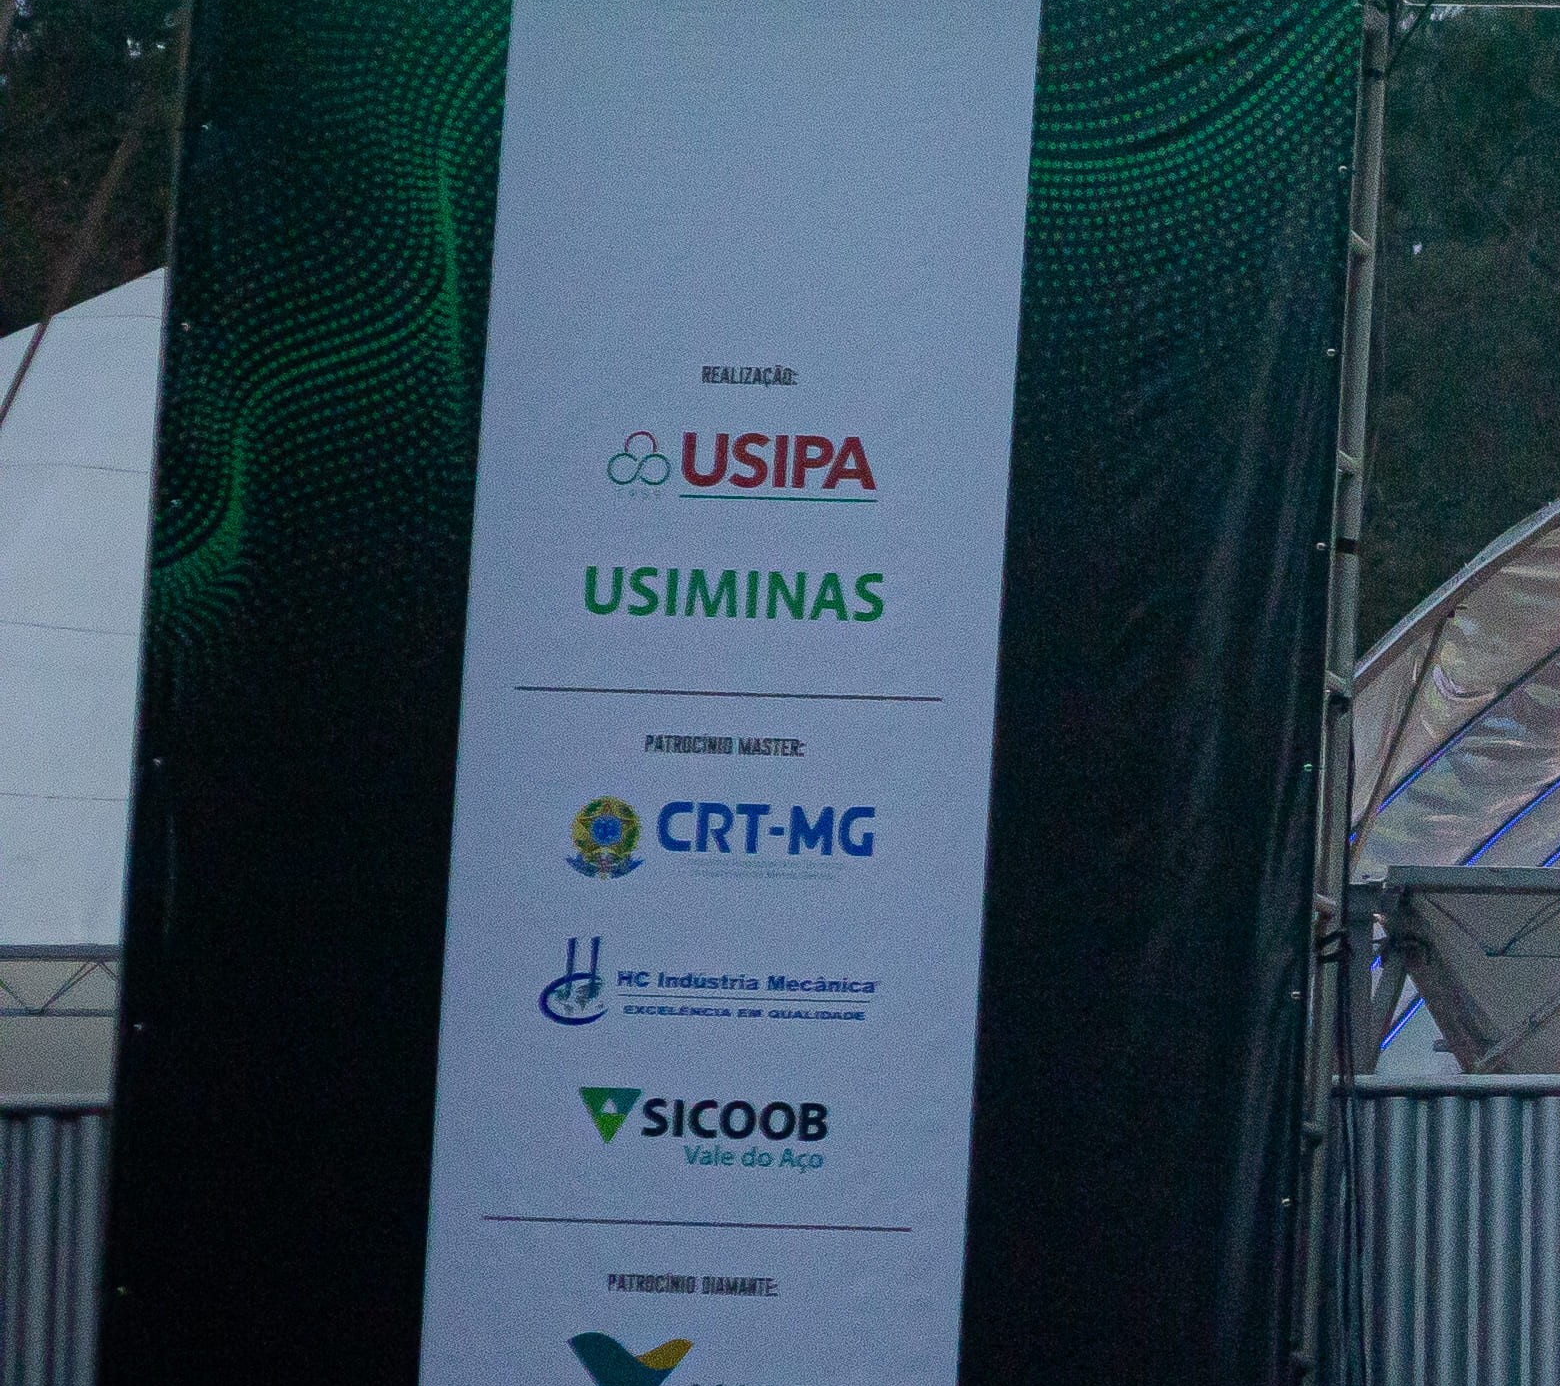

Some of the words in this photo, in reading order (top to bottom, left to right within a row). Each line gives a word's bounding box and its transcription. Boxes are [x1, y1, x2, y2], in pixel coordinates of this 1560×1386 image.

[702, 365, 798, 389] REALIZAÇÃO:
[681, 431, 877, 490] USIPA
[583, 565, 884, 623] USIMINAS
[738, 737, 805, 757] MASTER:
[657, 801, 874, 857] CRT-MG
[617, 970, 649, 988] HC
[657, 969, 760, 992] Indústria
[766, 973, 876, 994] Mecânica
[641, 1098, 828, 1142] SICOOB
[684, 1145, 734, 1167] Vale
[742, 1148, 773, 1169] do
[778, 1149, 824, 1173] Aço
